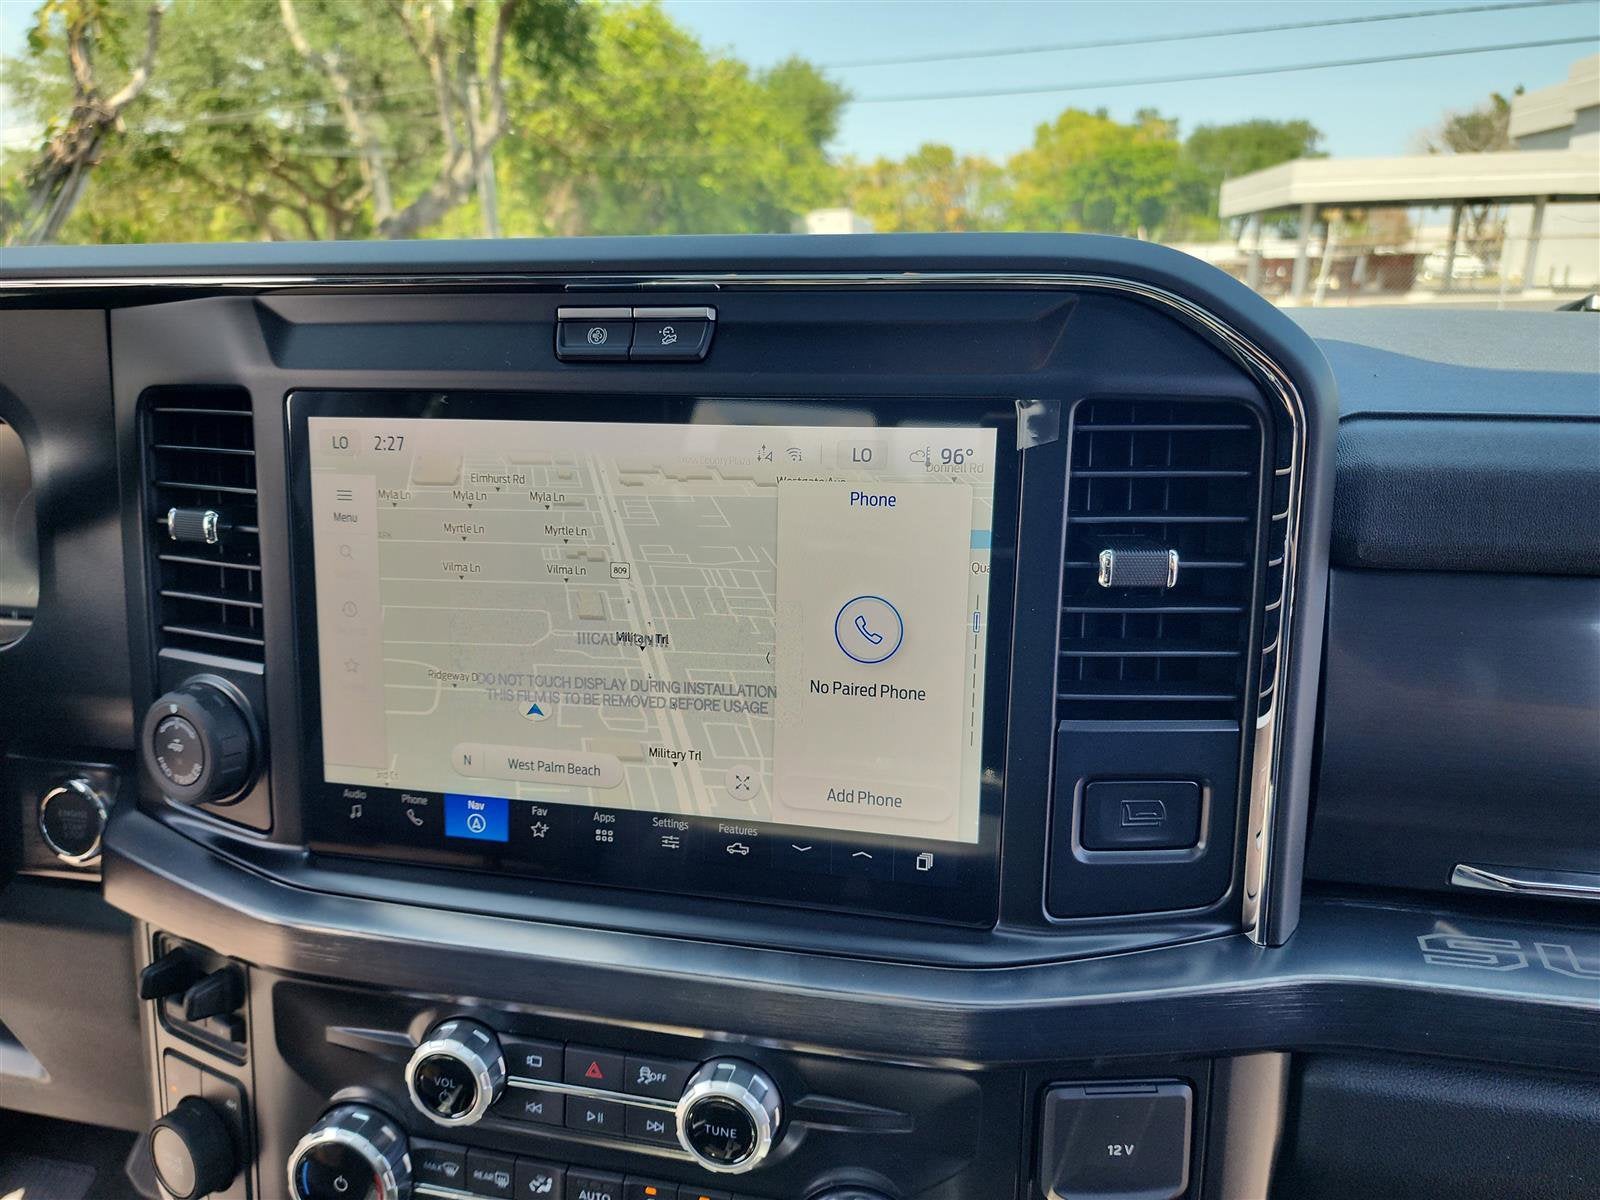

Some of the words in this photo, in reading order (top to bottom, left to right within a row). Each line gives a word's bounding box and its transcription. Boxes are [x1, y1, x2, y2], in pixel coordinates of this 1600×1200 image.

[332, 437, 349, 449] LO
[374, 436, 404, 451] 2:27
[852, 448, 872, 462] LO
[941, 448, 974, 465] 96°
[969, 463, 984, 474] Rd
[470, 473, 511, 485] Elmhurst
[512, 474, 525, 485] Rd
[453, 490, 474, 502] Myla
[474, 491, 487, 501] Ln
[530, 491, 551, 503] Myla
[553, 493, 565, 503] Ln
[850, 491, 897, 507] Phone
[333, 512, 358, 523] Menu
[444, 523, 472, 536] Myrtle
[473, 524, 485, 535] Ln
[544, 525, 574, 538] Myrtle
[575, 526, 587, 537] Ln
[443, 562, 467, 573] Vilma
[468, 563, 481, 573] Ln
[547, 564, 573, 575] Vilma
[574, 565, 587, 575] Ln
[613, 566, 627, 575] 809
[428, 669, 469, 682] Ridgeway
[499, 673, 524, 686] NOT
[528, 674, 571, 689] TOUCH
[575, 676, 626, 691] DISPLAY
[630, 680, 680, 694] DURING
[683, 681, 777, 698] INSTALLATION
[810, 680, 830, 694] No
[833, 681, 876, 697] Paired
[880, 684, 926, 701] Phone
[487, 689, 514, 701] THIS
[563, 692, 580, 705] TO
[583, 693, 600, 706] BE
[603, 694, 666, 709] REMOVED
[669, 697, 720, 712] BEFORE
[724, 700, 769, 714] USAGE
[649, 747, 686, 761] Military
[688, 750, 702, 761] Trl
[464, 754, 472, 766] N
[508, 758, 534, 771] West
[537, 760, 565, 773] Palm
[568, 762, 601, 776] Beach
[343, 789, 367, 800] Audio
[401, 794, 428, 806] Phone
[827, 788, 854, 804] Add
[858, 791, 902, 808] Phone
[468, 801, 485, 811] Nav
[532, 806, 548, 817] Fav
[593, 812, 616, 824] Apps
[652, 817, 689, 831] Settings
[718, 824, 758, 837] Features
[434, 1077, 456, 1089] VOL
[651, 1071, 667, 1083] OFF
[704, 1124, 738, 1139] TUNE
[1107, 1144, 1122, 1157] 12
[1123, 1144, 1135, 1157] V
[473, 1170, 494, 1182] REAR
[579, 1190, 611, 1200] AUTO
